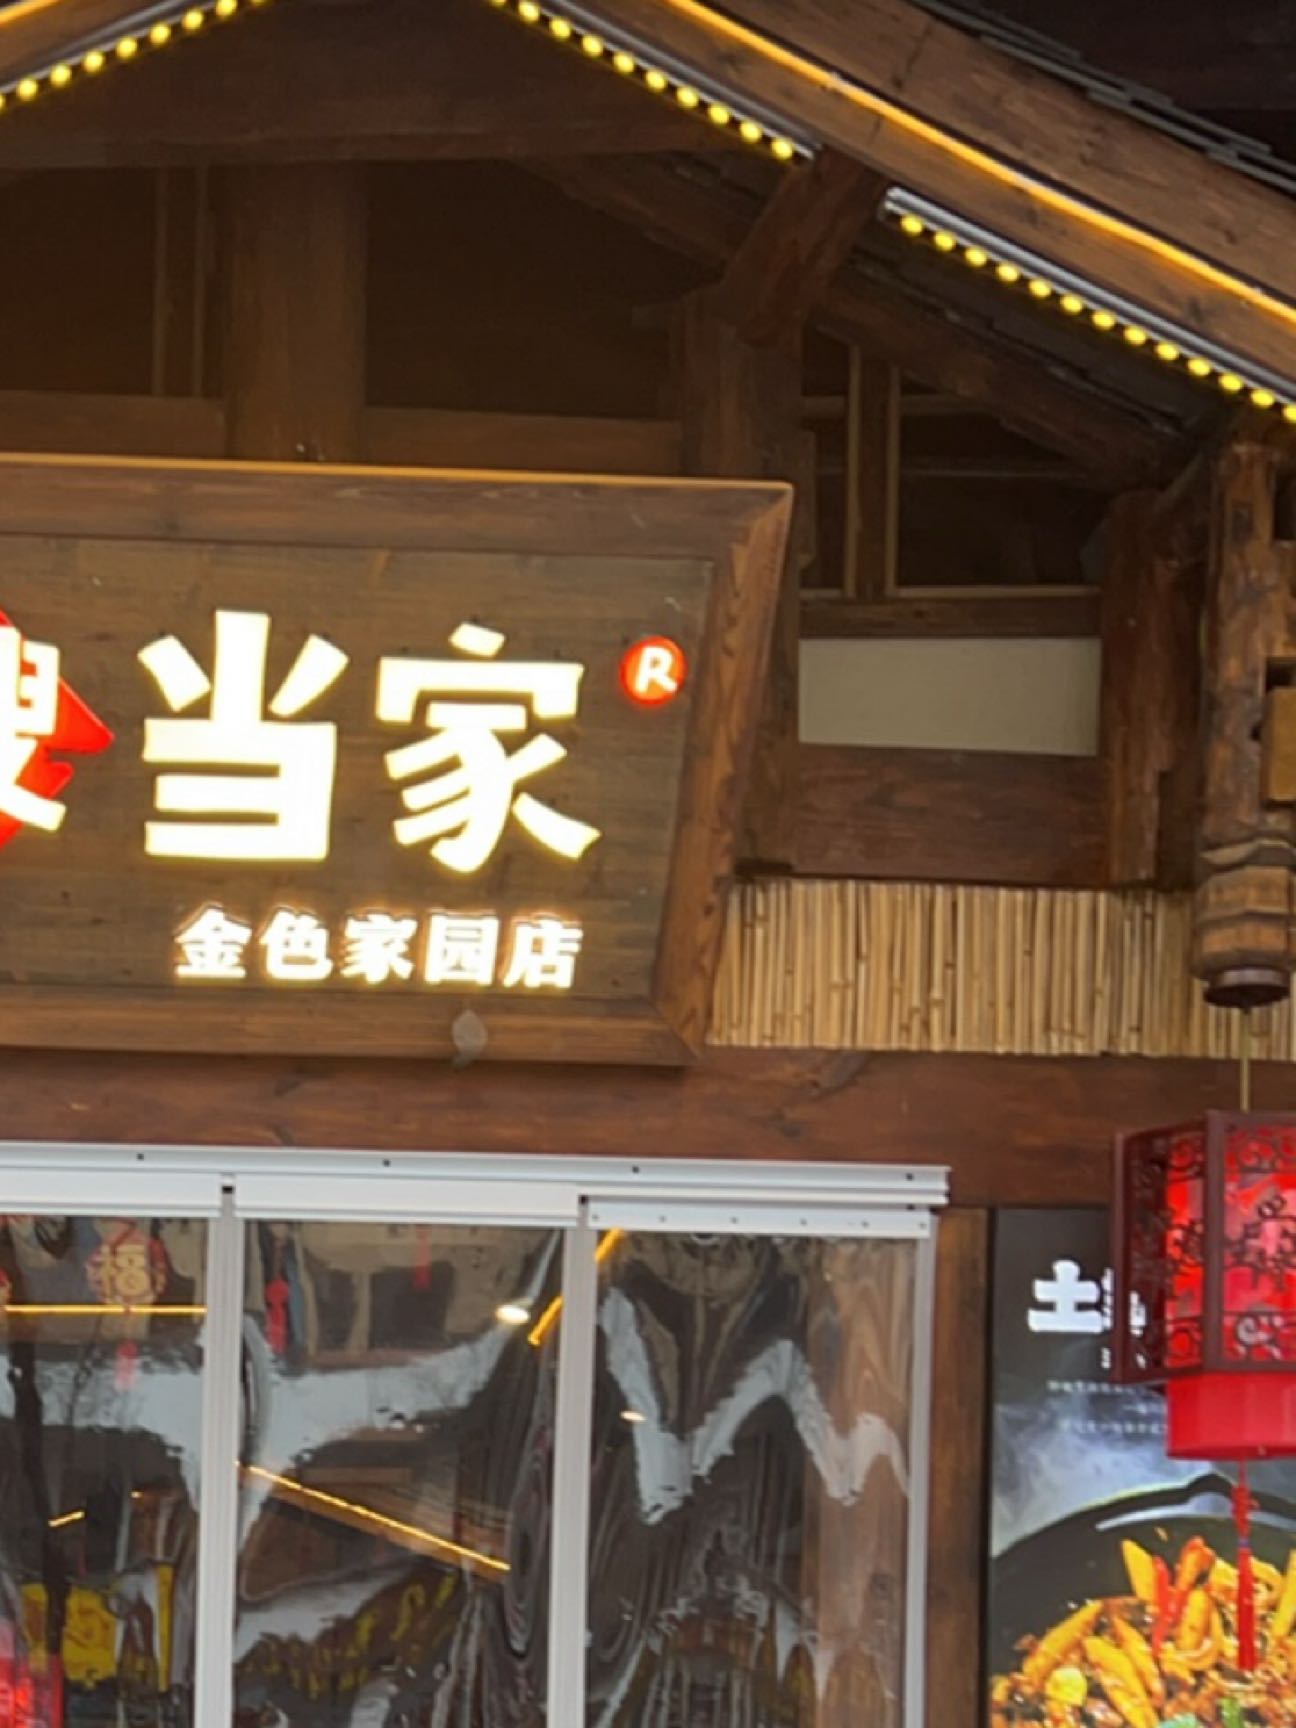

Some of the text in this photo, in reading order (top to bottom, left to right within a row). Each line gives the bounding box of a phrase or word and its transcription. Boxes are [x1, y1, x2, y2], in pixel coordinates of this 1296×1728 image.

[173, 906, 584, 990] 金色家园店
[1027, 1258, 1115, 1334] 土
